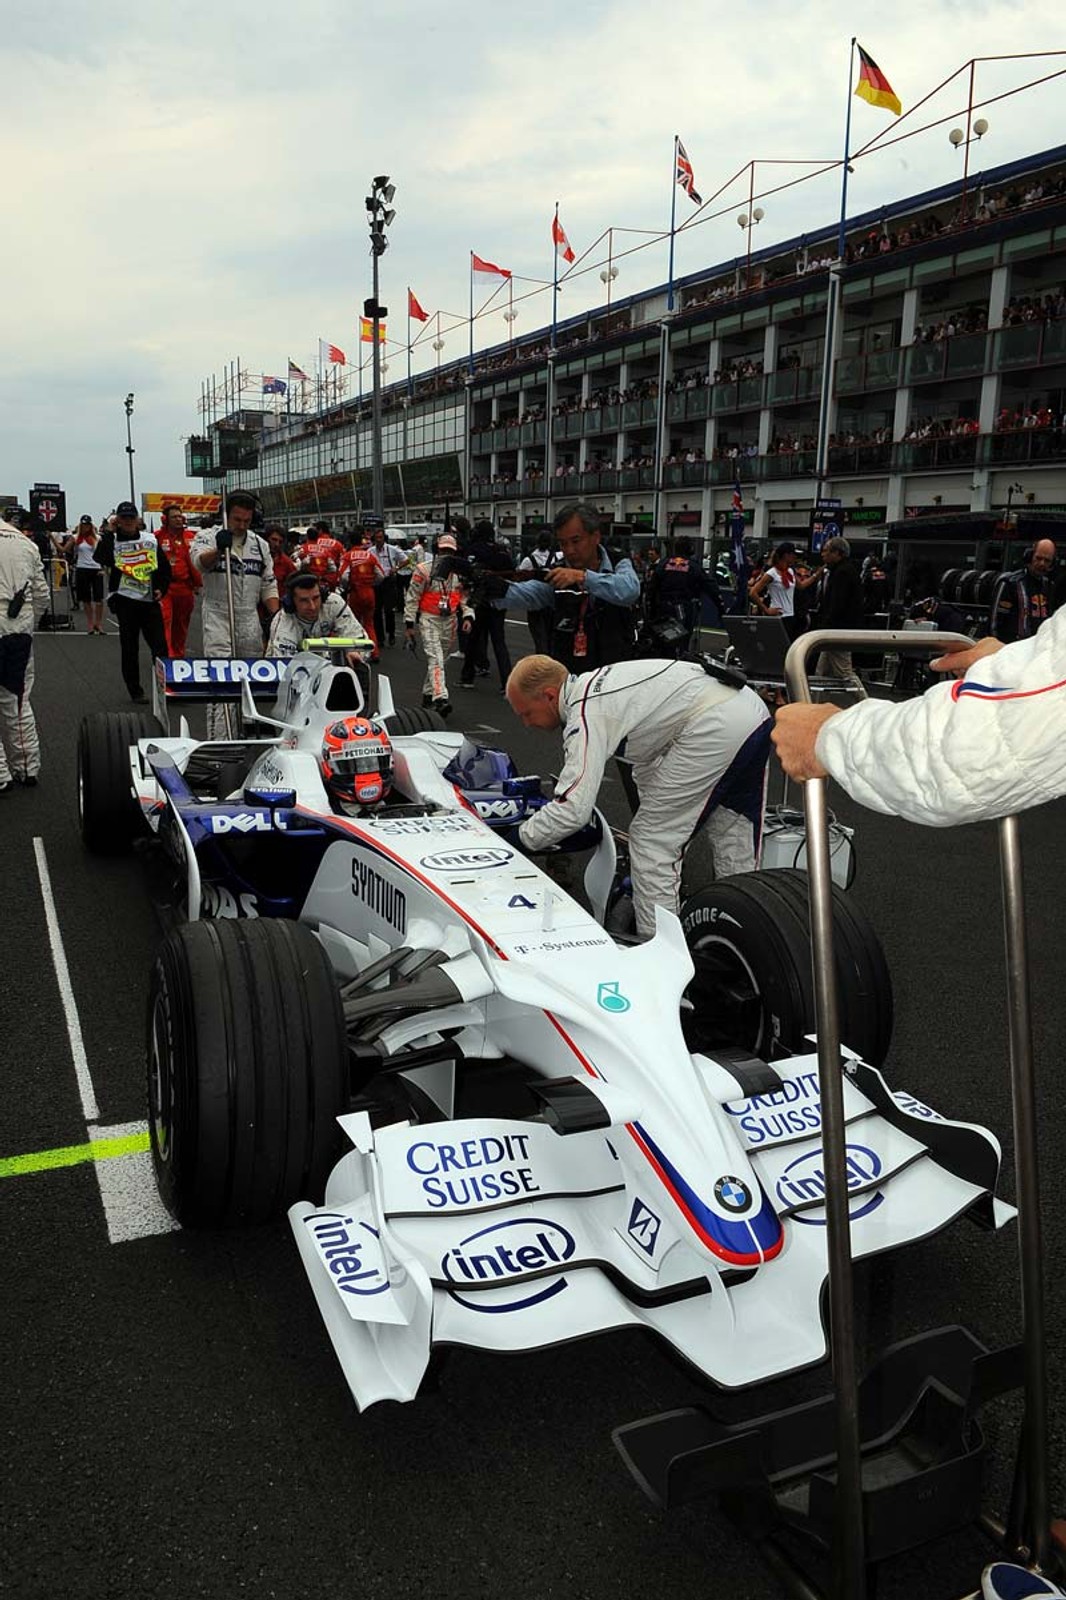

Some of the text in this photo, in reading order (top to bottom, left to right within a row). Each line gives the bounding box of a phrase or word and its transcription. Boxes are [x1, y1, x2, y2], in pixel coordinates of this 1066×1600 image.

[345, 747, 384, 758] PETRONAS
[212, 812, 287, 834] DELL
[352, 857, 406, 936] SYNTIUM
[508, 894, 537, 910] 4
[684, 907, 718, 934] STONE
[406, 1135, 529, 1175] CREDIT
[422, 1168, 540, 1208] SUISSE
[314, 1217, 380, 1284] intel
[451, 1233, 561, 1280] intel
